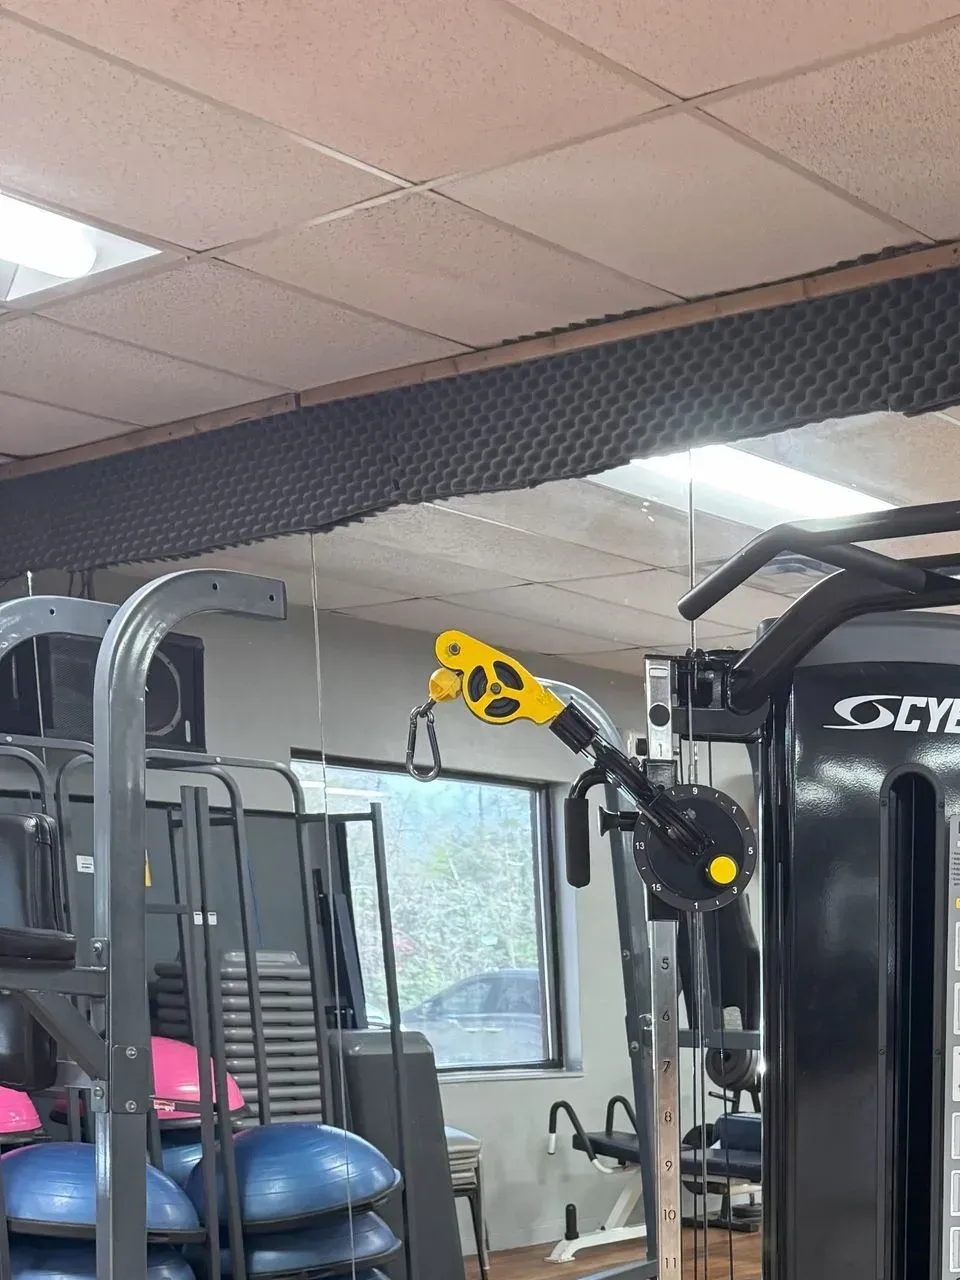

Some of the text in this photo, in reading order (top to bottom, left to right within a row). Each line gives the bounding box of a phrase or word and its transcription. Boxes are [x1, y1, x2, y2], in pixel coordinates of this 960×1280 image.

[692, 787, 698, 795] 9
[732, 806, 737, 814] 7
[635, 842, 645, 850] 13
[748, 847, 754, 855] 5
[651, 884, 662, 892] 15
[732, 886, 738, 894] 3
[694, 902, 698, 910] 1
[661, 957, 670, 970] 5
[662, 1010, 670, 1022] 6
[662, 1060, 671, 1073] 7
[664, 1111, 672, 1123] 8
[664, 1160, 673, 1172] 9
[663, 1209, 677, 1221] 10
[665, 1257, 677, 1269] 11
